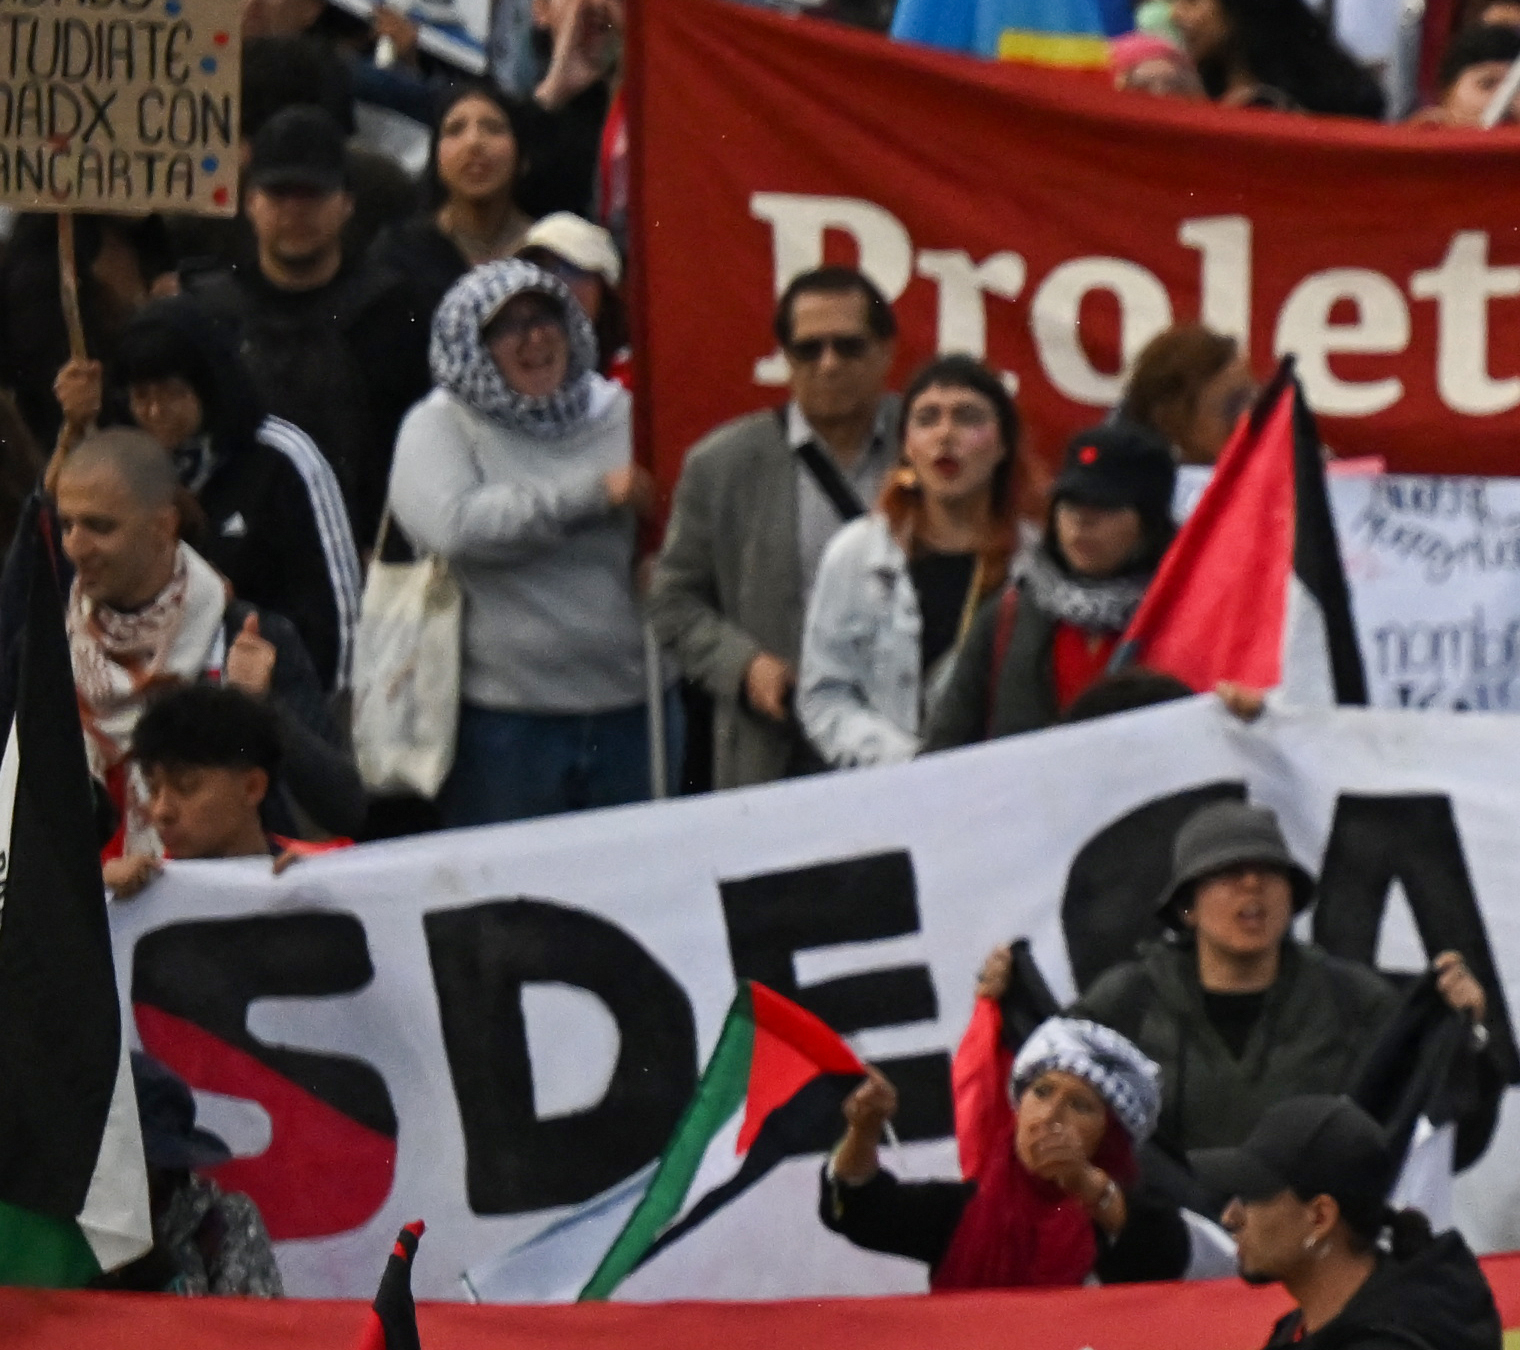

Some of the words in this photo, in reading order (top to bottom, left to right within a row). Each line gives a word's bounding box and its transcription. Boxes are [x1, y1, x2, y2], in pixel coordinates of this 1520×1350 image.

[0, 14, 193, 86] TUDIATE
[137, 86, 232, 149] CON
[131, 848, 957, 1242] SDE
